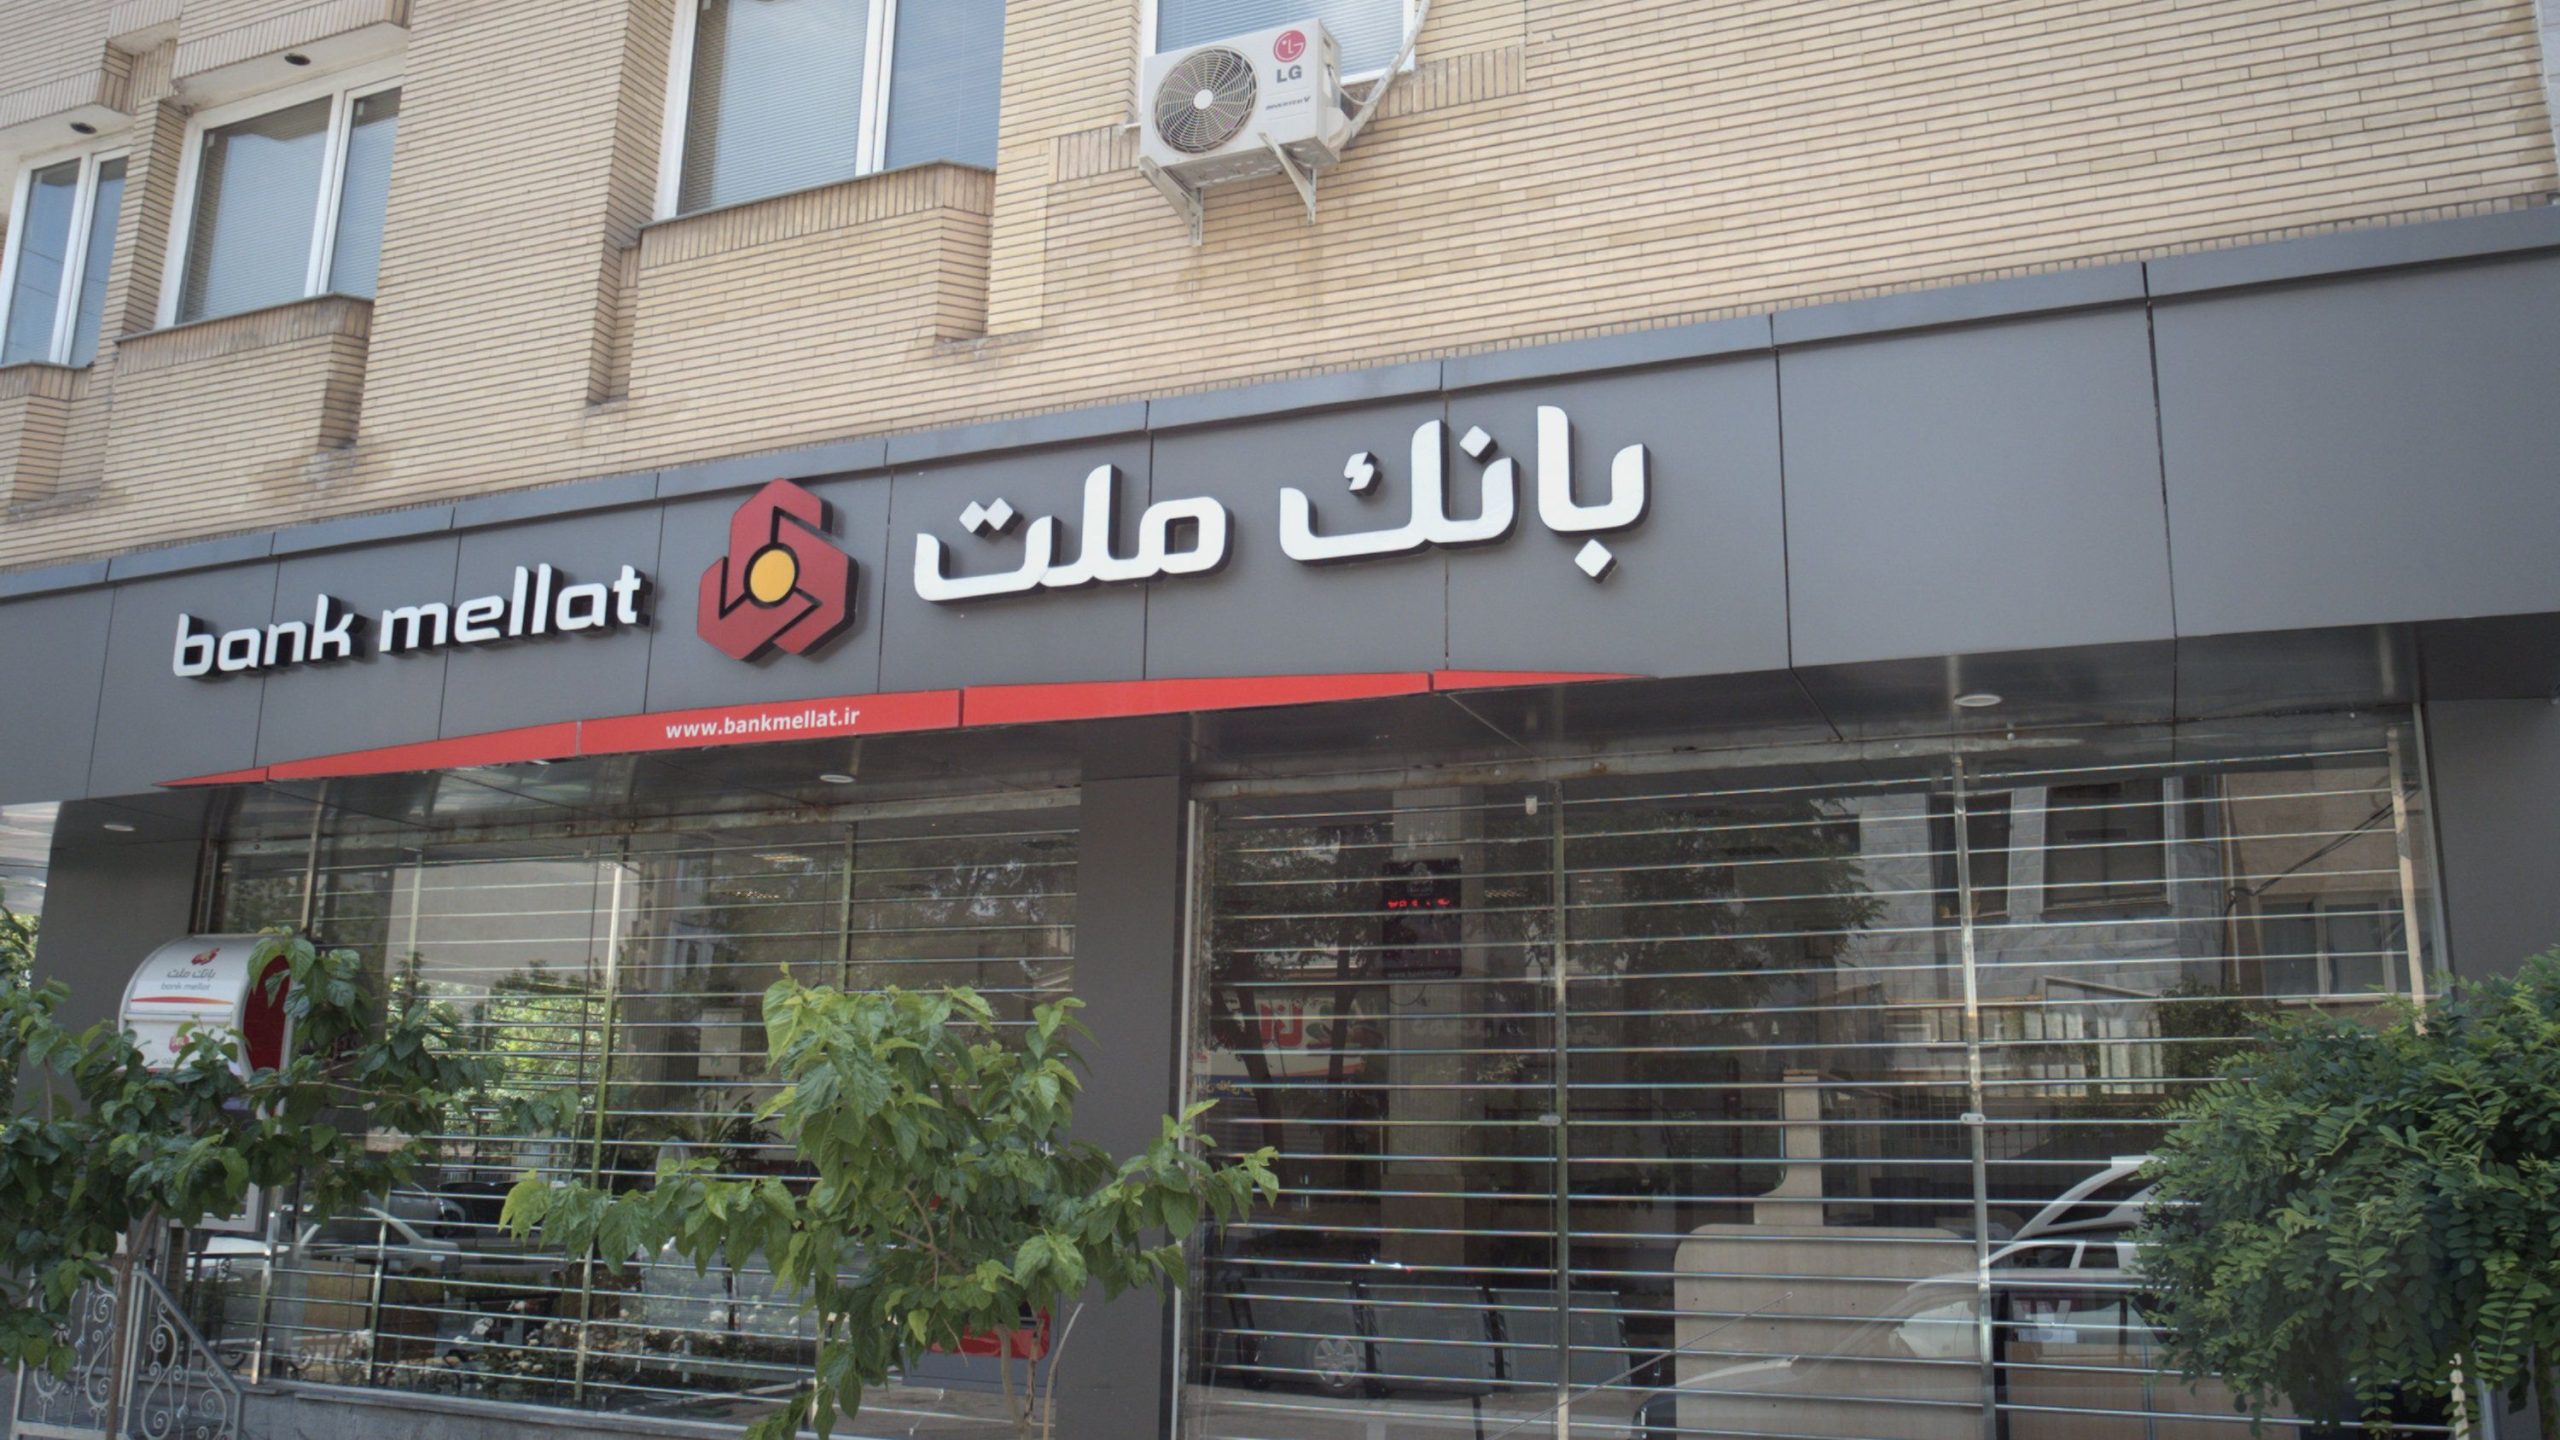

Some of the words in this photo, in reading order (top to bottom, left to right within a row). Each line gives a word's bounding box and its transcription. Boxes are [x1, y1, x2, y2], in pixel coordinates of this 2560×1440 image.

[1276, 65, 1302, 83] LG
[914, 464, 1227, 602] ملت
[173, 594, 356, 677] bank
[379, 563, 642, 653] mellat
[665, 708, 861, 739] www.bankmellat.ir
